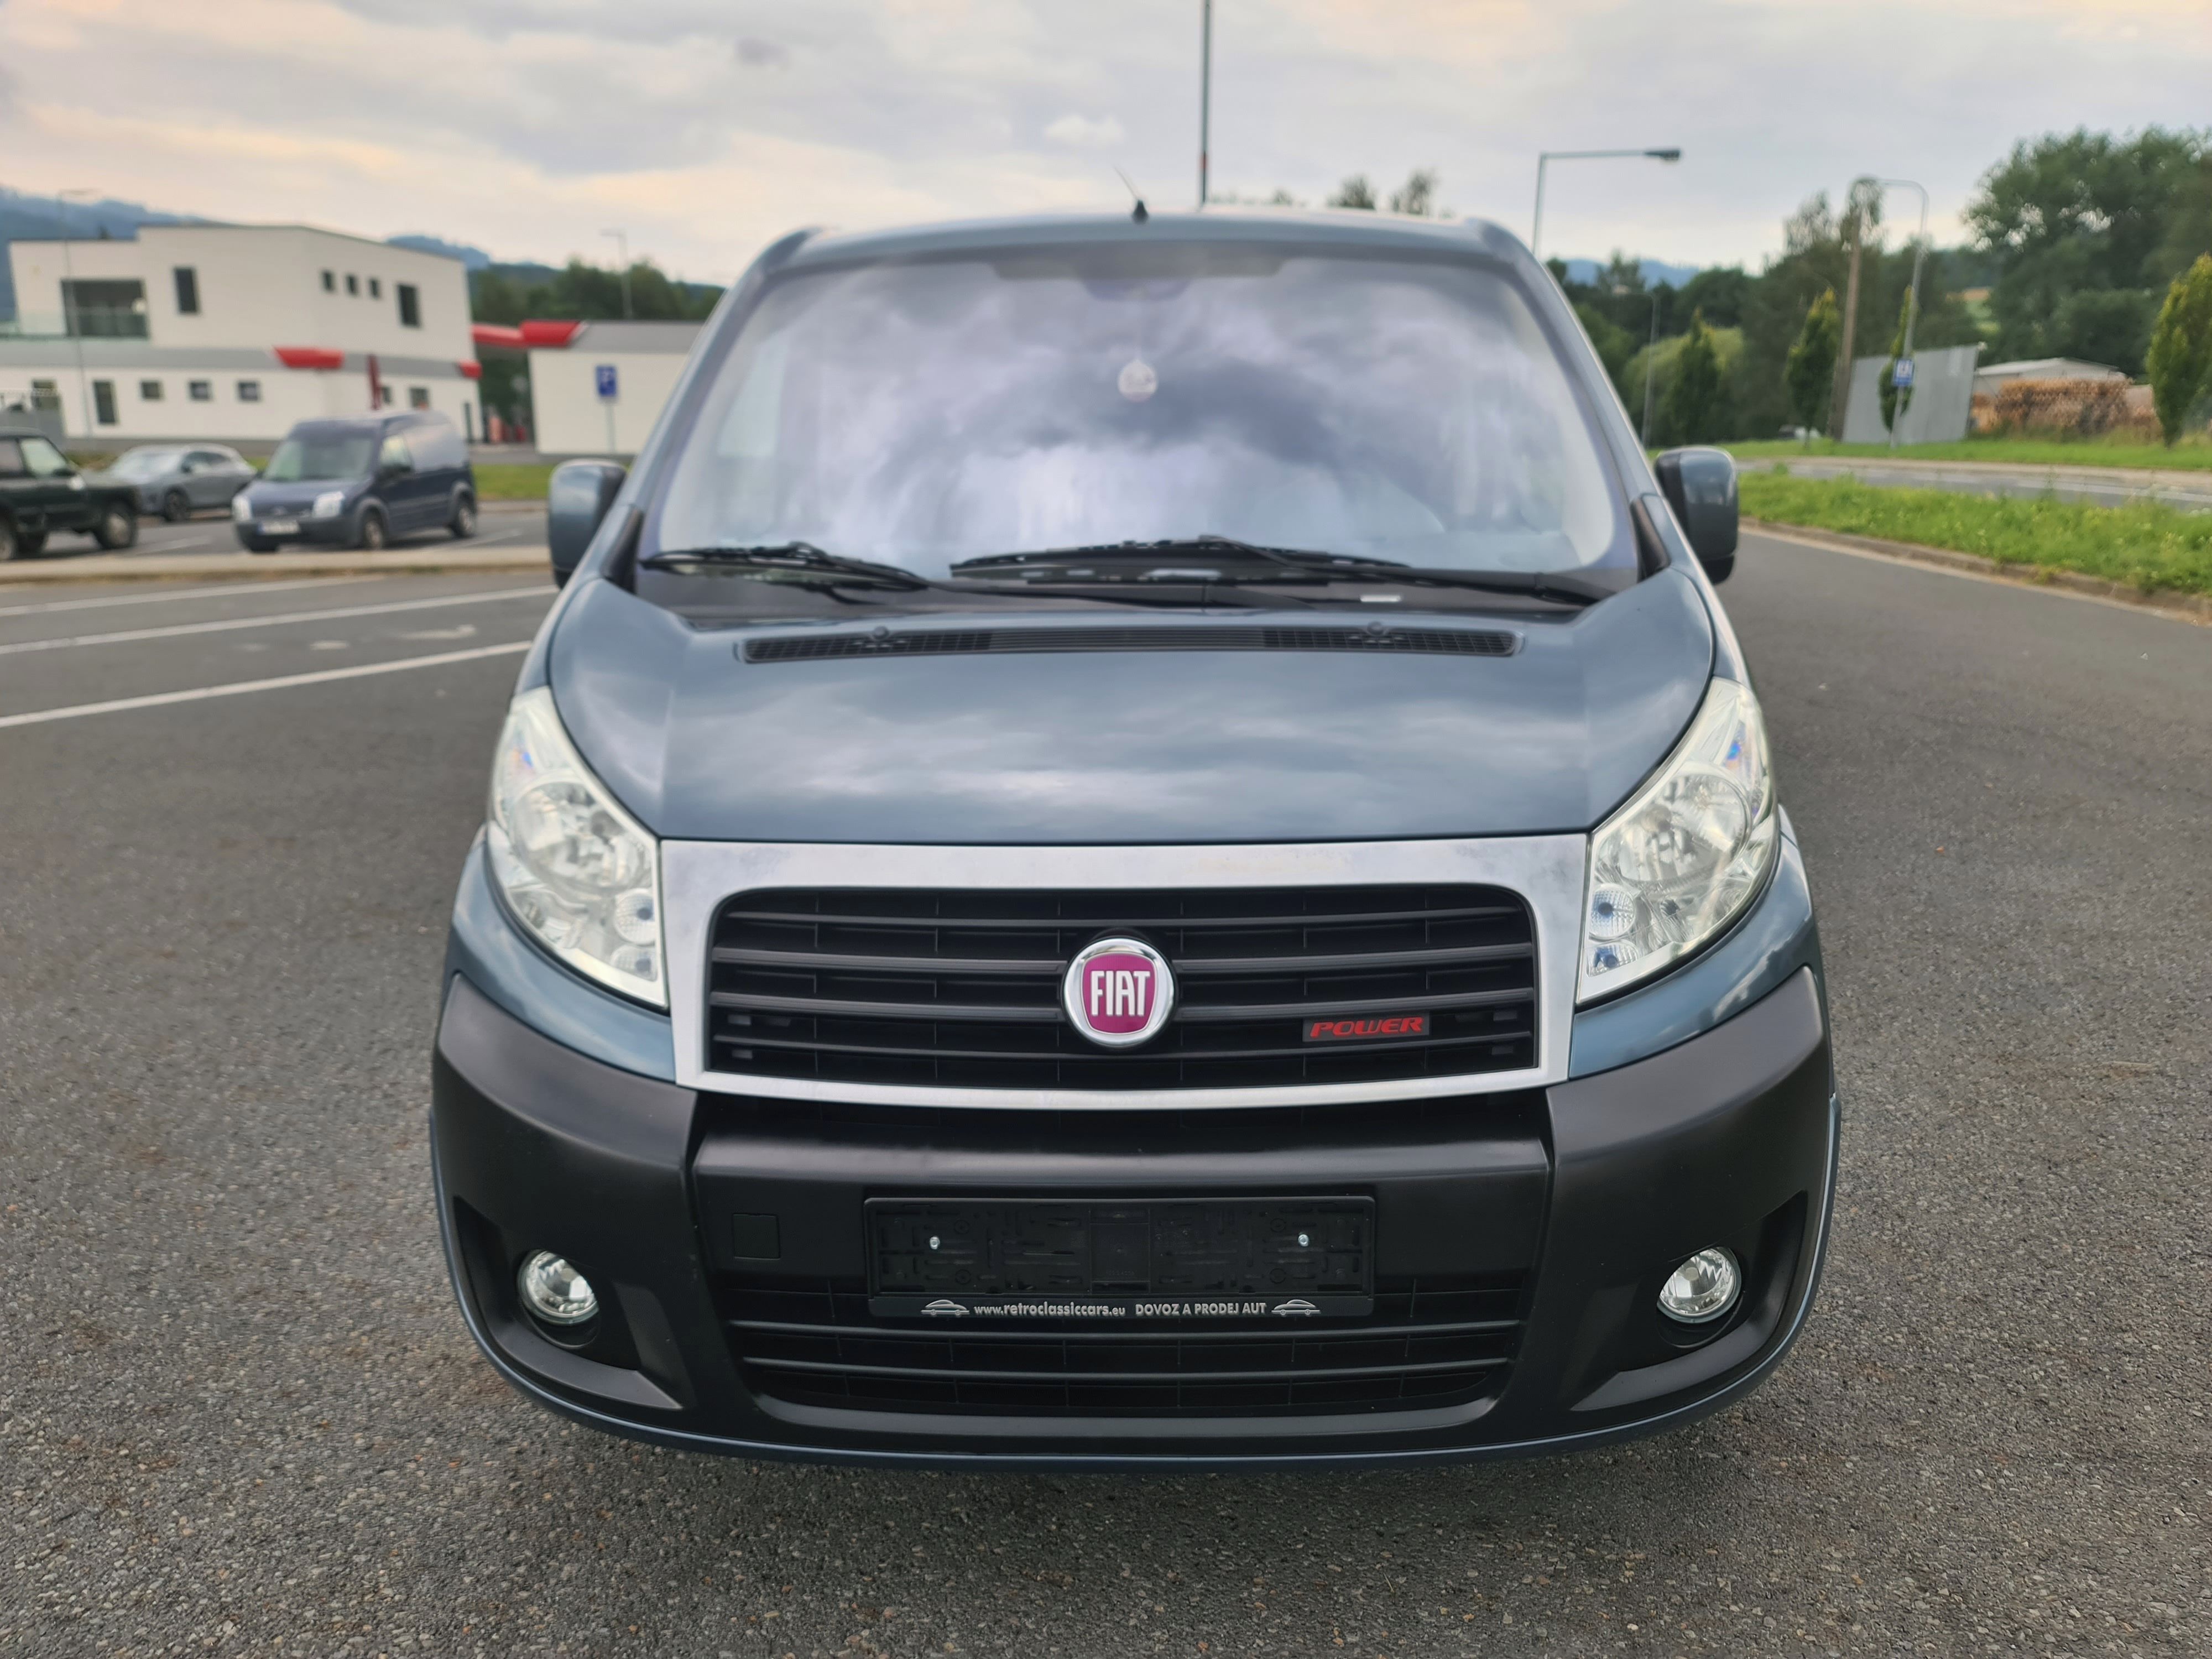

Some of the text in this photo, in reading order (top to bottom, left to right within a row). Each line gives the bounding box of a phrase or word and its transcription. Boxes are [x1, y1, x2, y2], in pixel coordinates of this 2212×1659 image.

[1090, 970, 1151, 1017] FIAT
[1310, 1016, 1424, 1039] POWER
[973, 1301, 1266, 1316] www.retroclassiccars.eu DOVOZ A PRODEJ AUT
